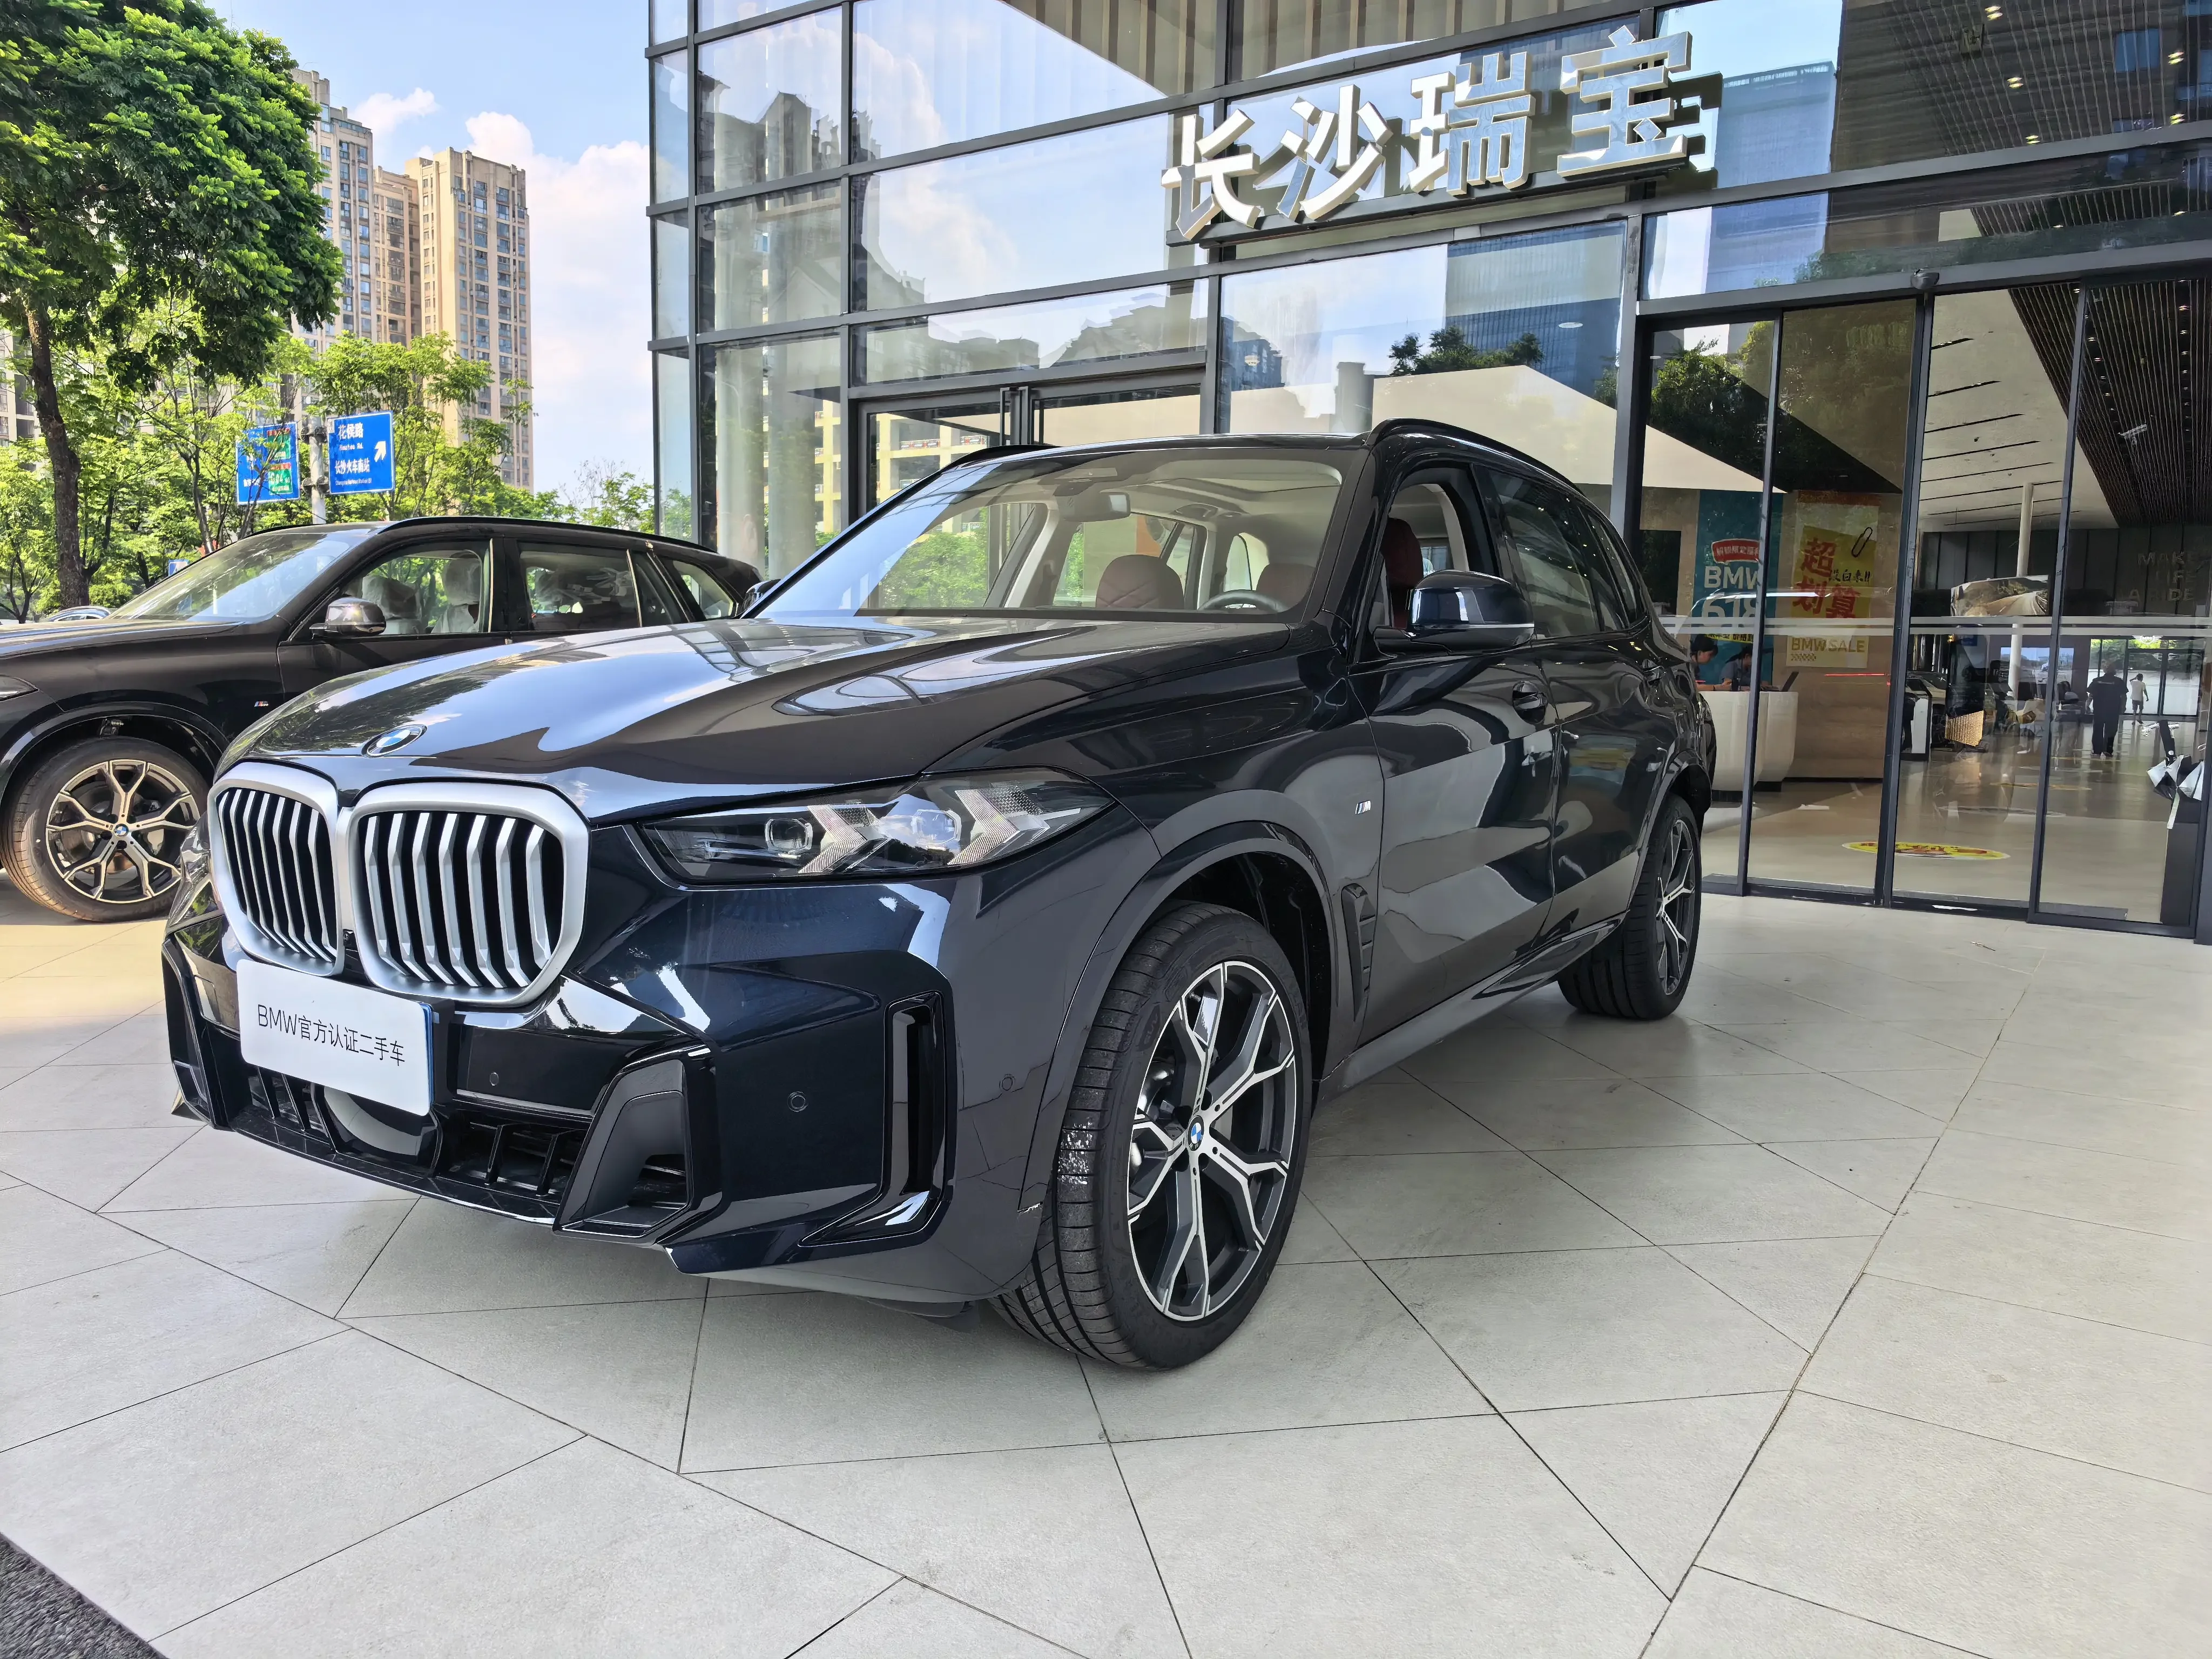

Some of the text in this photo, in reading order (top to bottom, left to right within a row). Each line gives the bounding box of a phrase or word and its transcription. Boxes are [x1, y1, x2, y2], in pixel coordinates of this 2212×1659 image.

[1161, 25, 1693, 239] 长沙瑞宝
[335, 457, 370, 474] 长沙火车南站
[258, 1004, 405, 1066] BMW官方认证二手车
